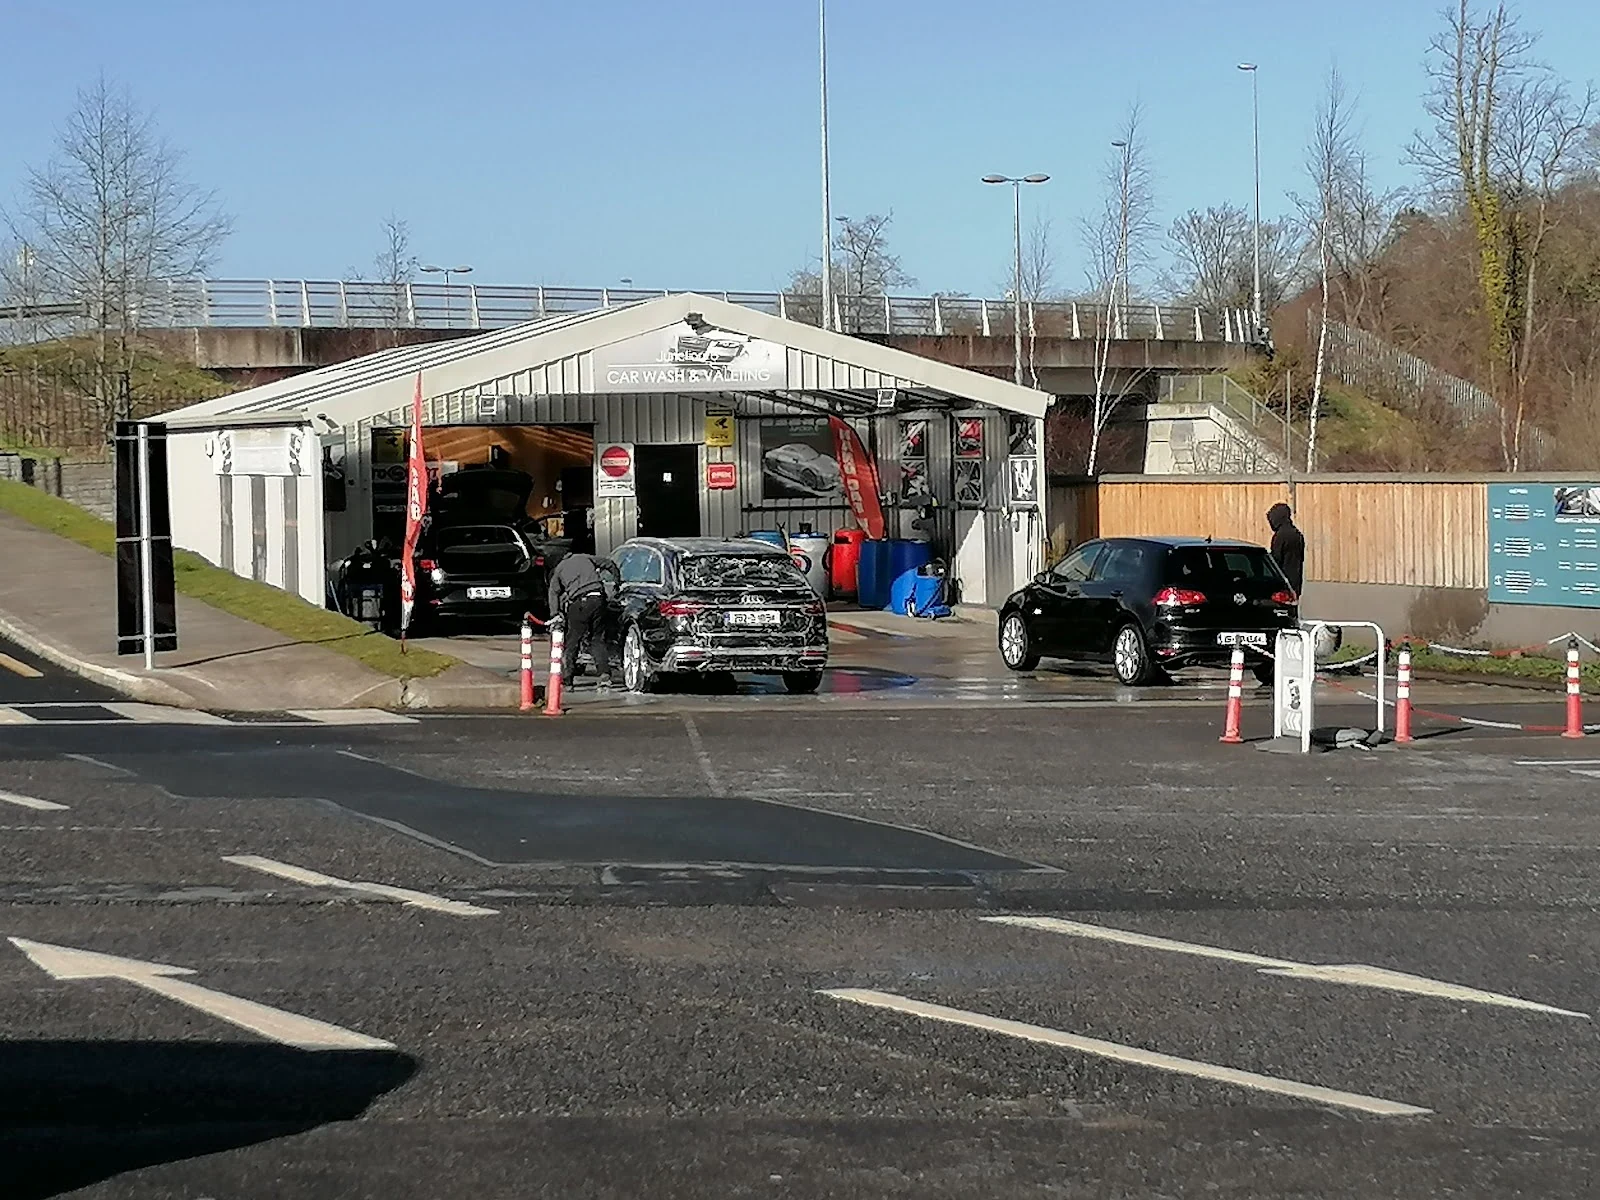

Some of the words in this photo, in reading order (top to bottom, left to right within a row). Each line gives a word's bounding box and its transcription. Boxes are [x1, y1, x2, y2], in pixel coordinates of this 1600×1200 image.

[607, 370, 639, 385] CAR
[643, 370, 685, 384] WASH
[688, 371, 700, 382] &
